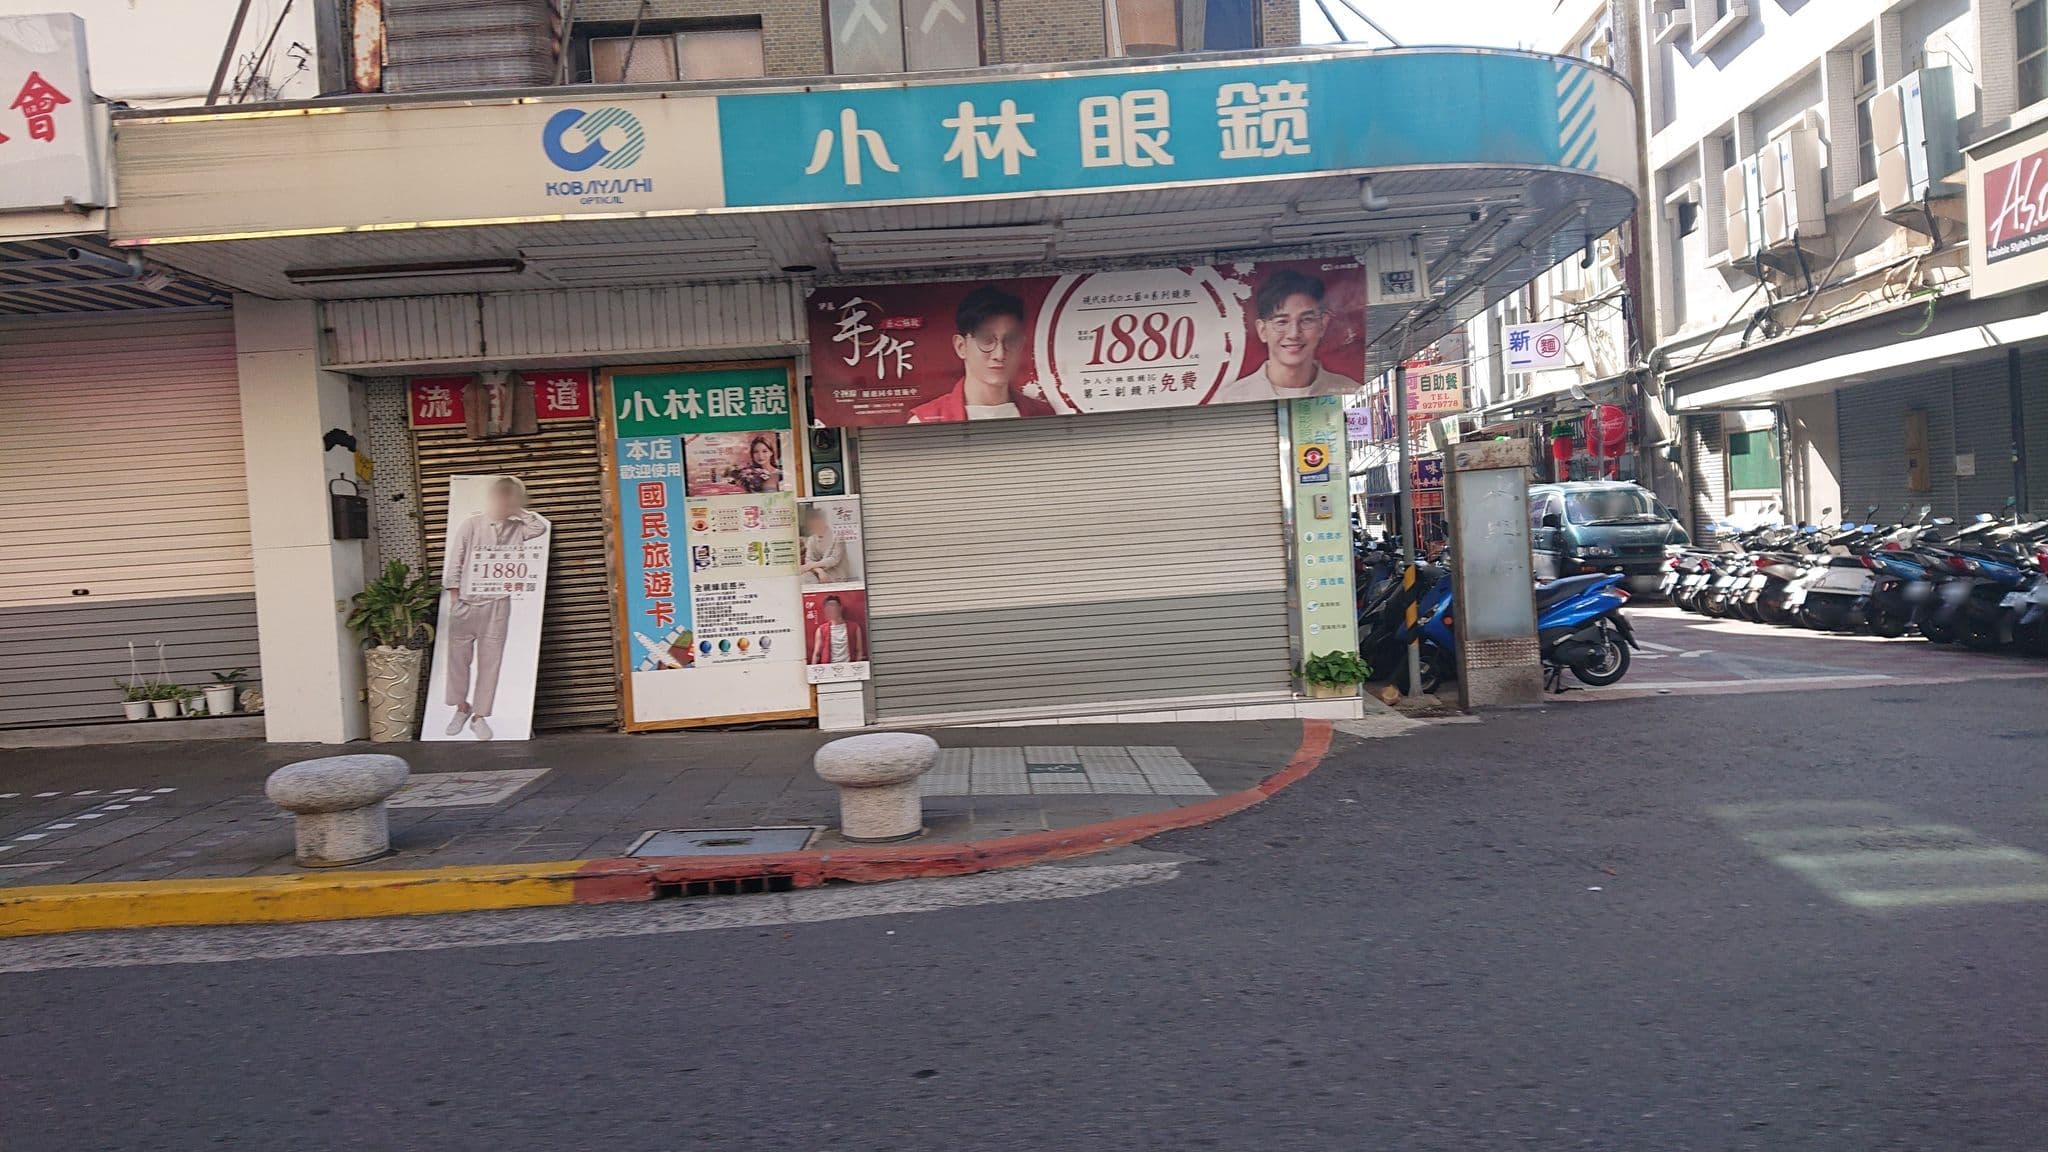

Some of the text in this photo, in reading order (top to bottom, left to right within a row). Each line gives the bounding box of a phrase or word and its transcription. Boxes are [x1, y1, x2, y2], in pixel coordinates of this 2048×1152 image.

[0, 70, 72, 143] 會
[805, 79, 1311, 186] 小林眼鏡
[545, 178, 653, 196] KOBAYASHI
[579, 196, 624, 205] OPTICAL
[1085, 311, 1195, 366] 1880
[1160, 371, 1198, 392] 免費
[1420, 372, 1458, 392] 自助餐
[618, 383, 788, 422] 小林眼鏡
[1430, 393, 1450, 401] TEL
[625, 438, 673, 461] 本店
[619, 462, 681, 480] 歡迎使用
[637, 481, 675, 629] 國民旅遊卡
[480, 562, 528, 579] 1880
